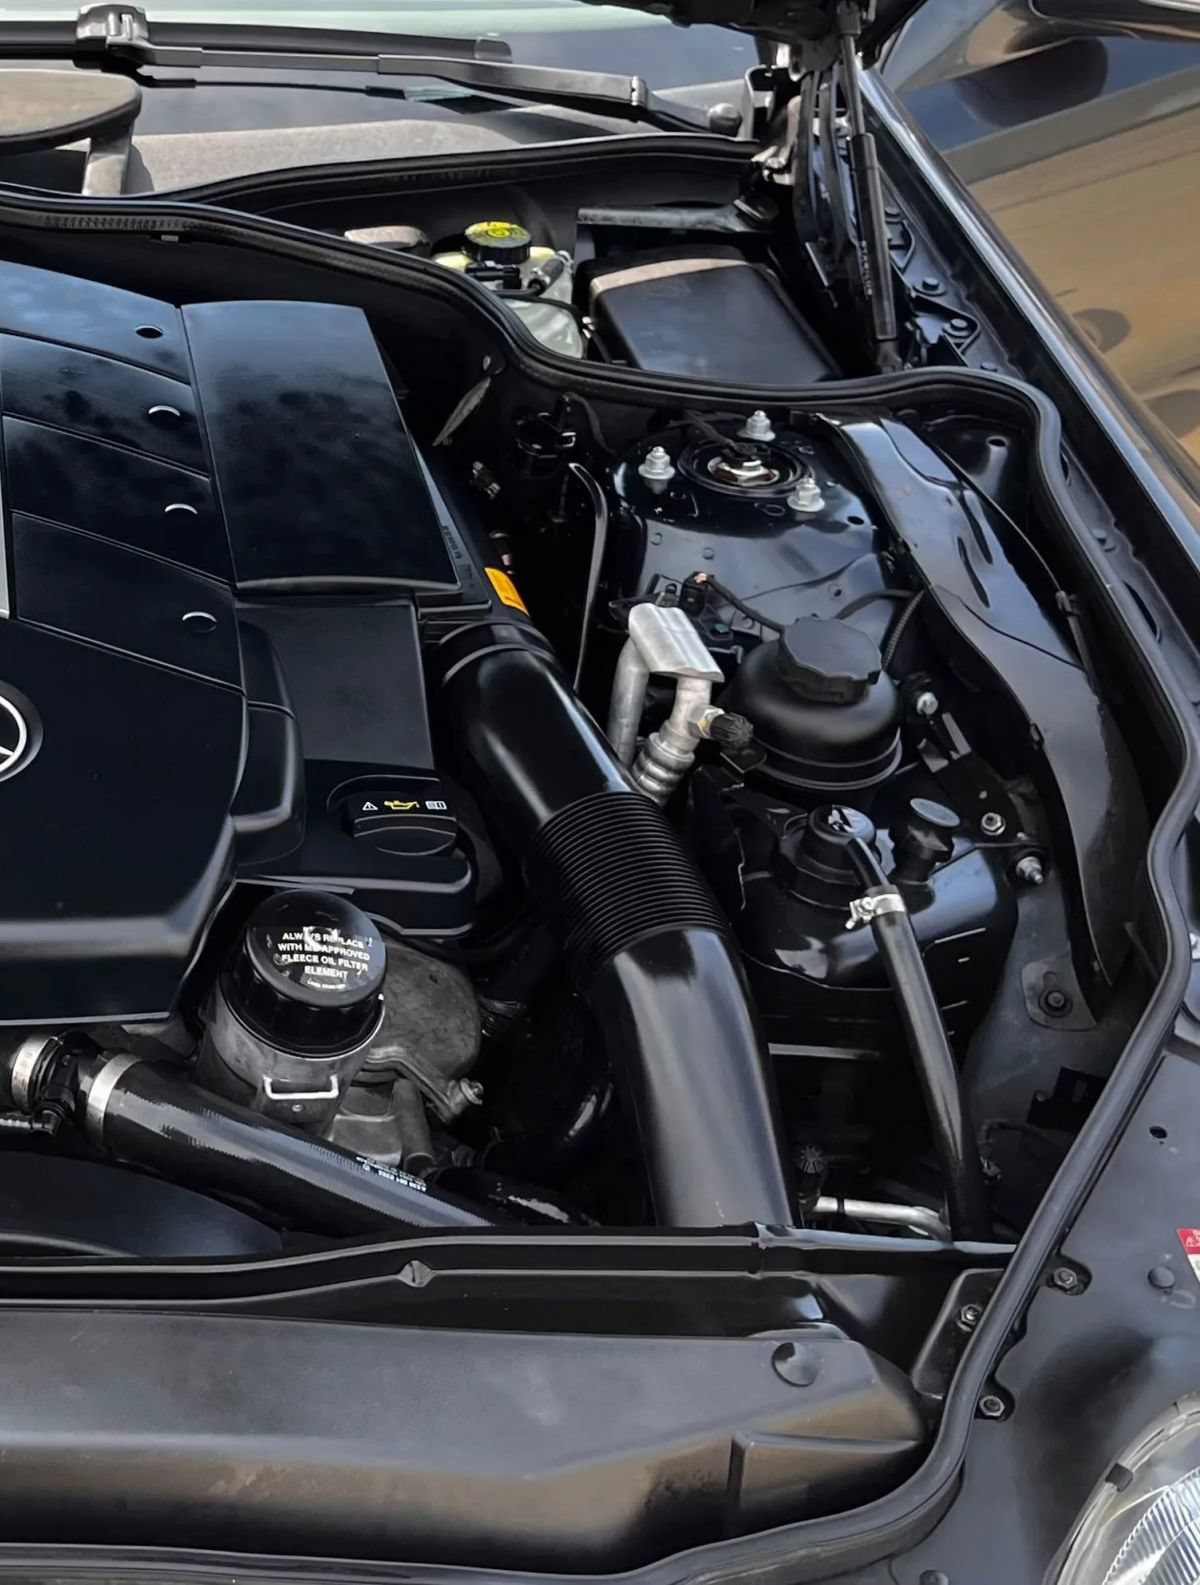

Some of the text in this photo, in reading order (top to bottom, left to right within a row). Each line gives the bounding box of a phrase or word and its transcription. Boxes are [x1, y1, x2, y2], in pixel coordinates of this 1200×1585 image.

[282, 932, 321, 941] ALWYS
[277, 943, 303, 952] WITH
[281, 953, 368, 971] FLEECE OIL FILTER
[304, 965, 348, 978] ELEMENT
